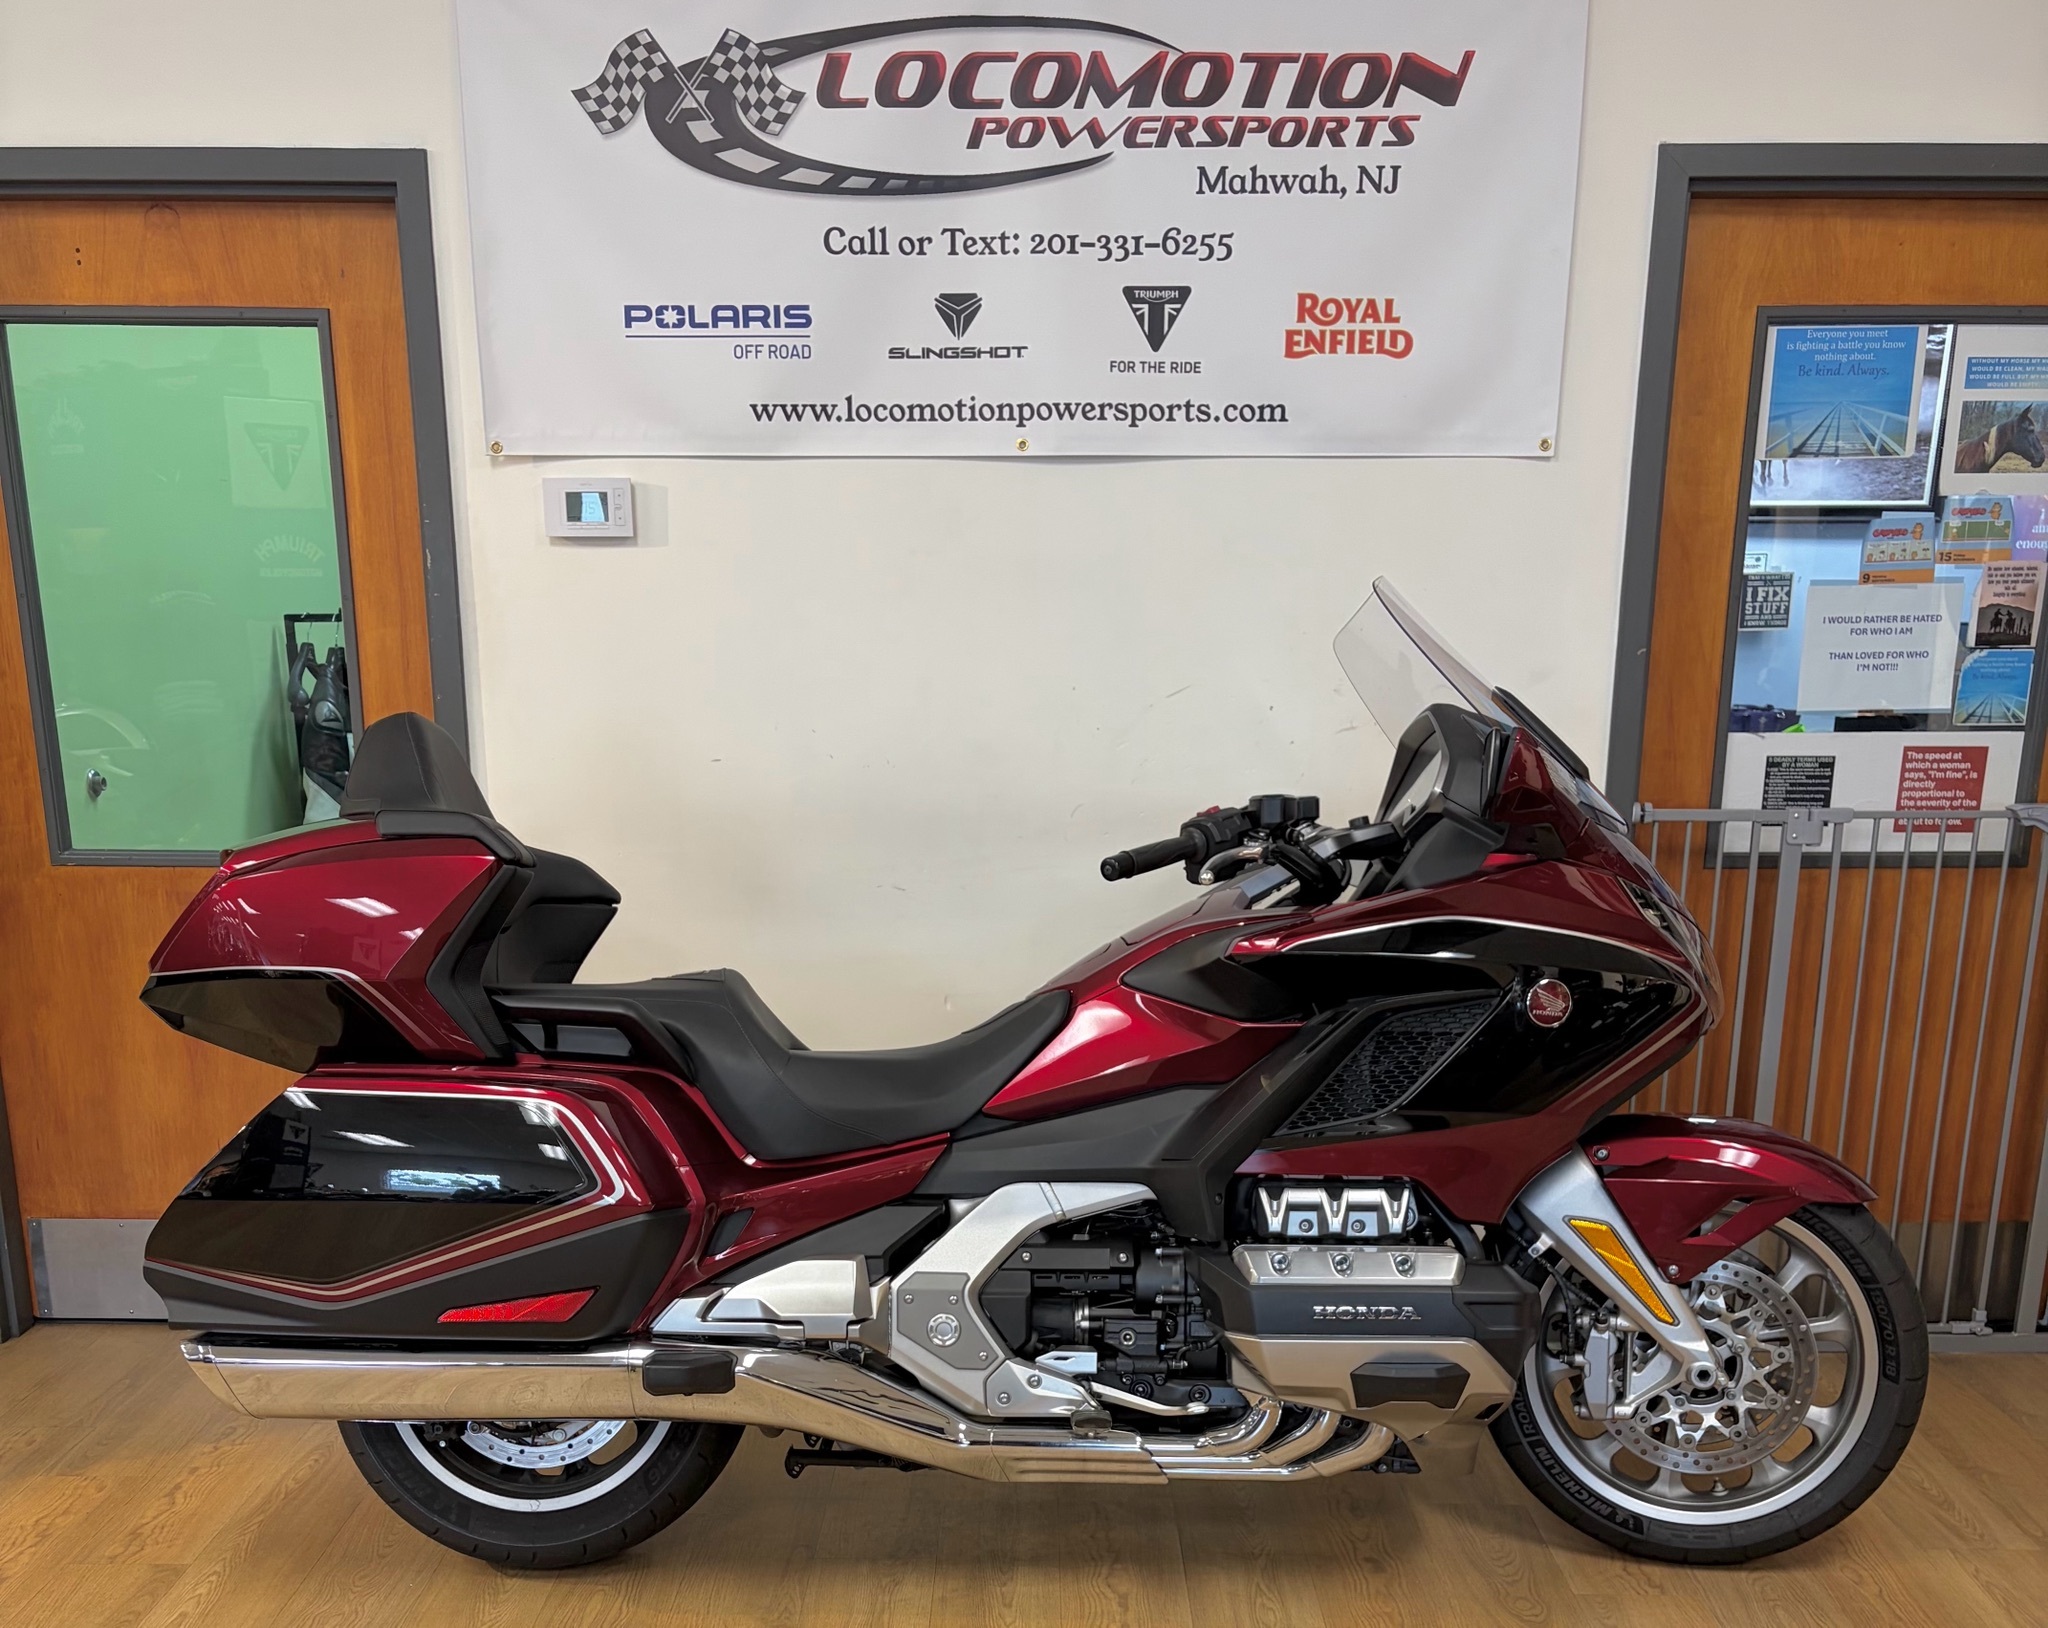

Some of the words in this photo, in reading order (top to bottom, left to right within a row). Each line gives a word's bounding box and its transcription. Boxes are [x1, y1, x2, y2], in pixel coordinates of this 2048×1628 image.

[816, 49, 1476, 110] LOCOMOTION
[966, 115, 1421, 150] POWERSPORTS
[1195, 164, 1348, 200] Mahwah,
[1356, 164, 1402, 195] NJ
[823, 226, 890, 256] Call
[898, 236, 933, 256] or
[940, 227, 1020, 256] Text:
[1029, 226, 1235, 263] 201-331-6255
[1133, 289, 1180, 300] TRIUMPH
[623, 304, 813, 329] POLARIS
[1296, 292, 1401, 327] ROYAL
[1807, 330, 1847, 340] Everyone
[1849, 331, 1865, 340] you
[1867, 329, 1889, 338] meet
[1284, 329, 1414, 359] ENFIELD
[1787, 341, 1795, 350] is
[1796, 341, 1829, 351] fighting
[1838, 340, 1863, 349] battle
[1864, 342, 1880, 351] you
[1882, 340, 1906, 349] know
[733, 344, 765, 360] OFF
[768, 344, 812, 360] ROAD
[888, 345, 1029, 360] SLINGSHOT
[1814, 352, 1848, 363] nothing
[1849, 352, 1877, 361] about.
[1109, 360, 1136, 374] FOR
[1139, 360, 1166, 374] THE
[1170, 361, 1202, 374] RIDE
[1798, 364, 1812, 377] Be
[1815, 363, 1845, 377] kind.
[1847, 363, 1890, 380] Always.
[749, 394, 1289, 428] www.locomotionpowersports.com
[1938, 551, 1952, 562] 15
[1862, 573, 1871, 584] 9
[1745, 586, 1753, 602] I
[1756, 586, 1790, 602] FIX
[1744, 601, 1789, 615] STUFF
[1822, 616, 1826, 624] I
[1827, 616, 1862, 625] WOULD
[1864, 615, 1899, 624] RATHER
[1900, 614, 1912, 623] BE
[1912, 614, 1943, 623] HATED
[1849, 628, 1868, 636] FOR
[1870, 627, 1893, 636] WHO
[1894, 627, 1898, 635] I
[1899, 627, 1913, 635] AM
[1829, 652, 1854, 660] THAN
[1855, 651, 1885, 660] LOVED
[1886, 651, 1905, 659] FOR
[1905, 650, 1930, 659] WHO
[1856, 663, 1870, 672] I'M
[1871, 663, 1899, 672] NOT!!!
[1907, 751, 1924, 760] The
[1924, 751, 1952, 761] speed
[1953, 751, 1962, 760] at
[1905, 761, 1931, 770] which
[1904, 772, 1927, 780] says,
[1969, 771, 1978, 779] is
[1903, 780, 1936, 789] directly
[1901, 789, 1955, 798] proportional
[1956, 790, 1966, 798] to
[1900, 799, 1915, 807] the
[1916, 799, 1951, 808] severity
[1952, 799, 1962, 807] of
[1962, 799, 1978, 807] the
[1312, 1305, 1422, 1321] HONDA
[1870, 1288, 1895, 1341] 130/70
[1535, 1445, 1616, 1518] MICHELIN
